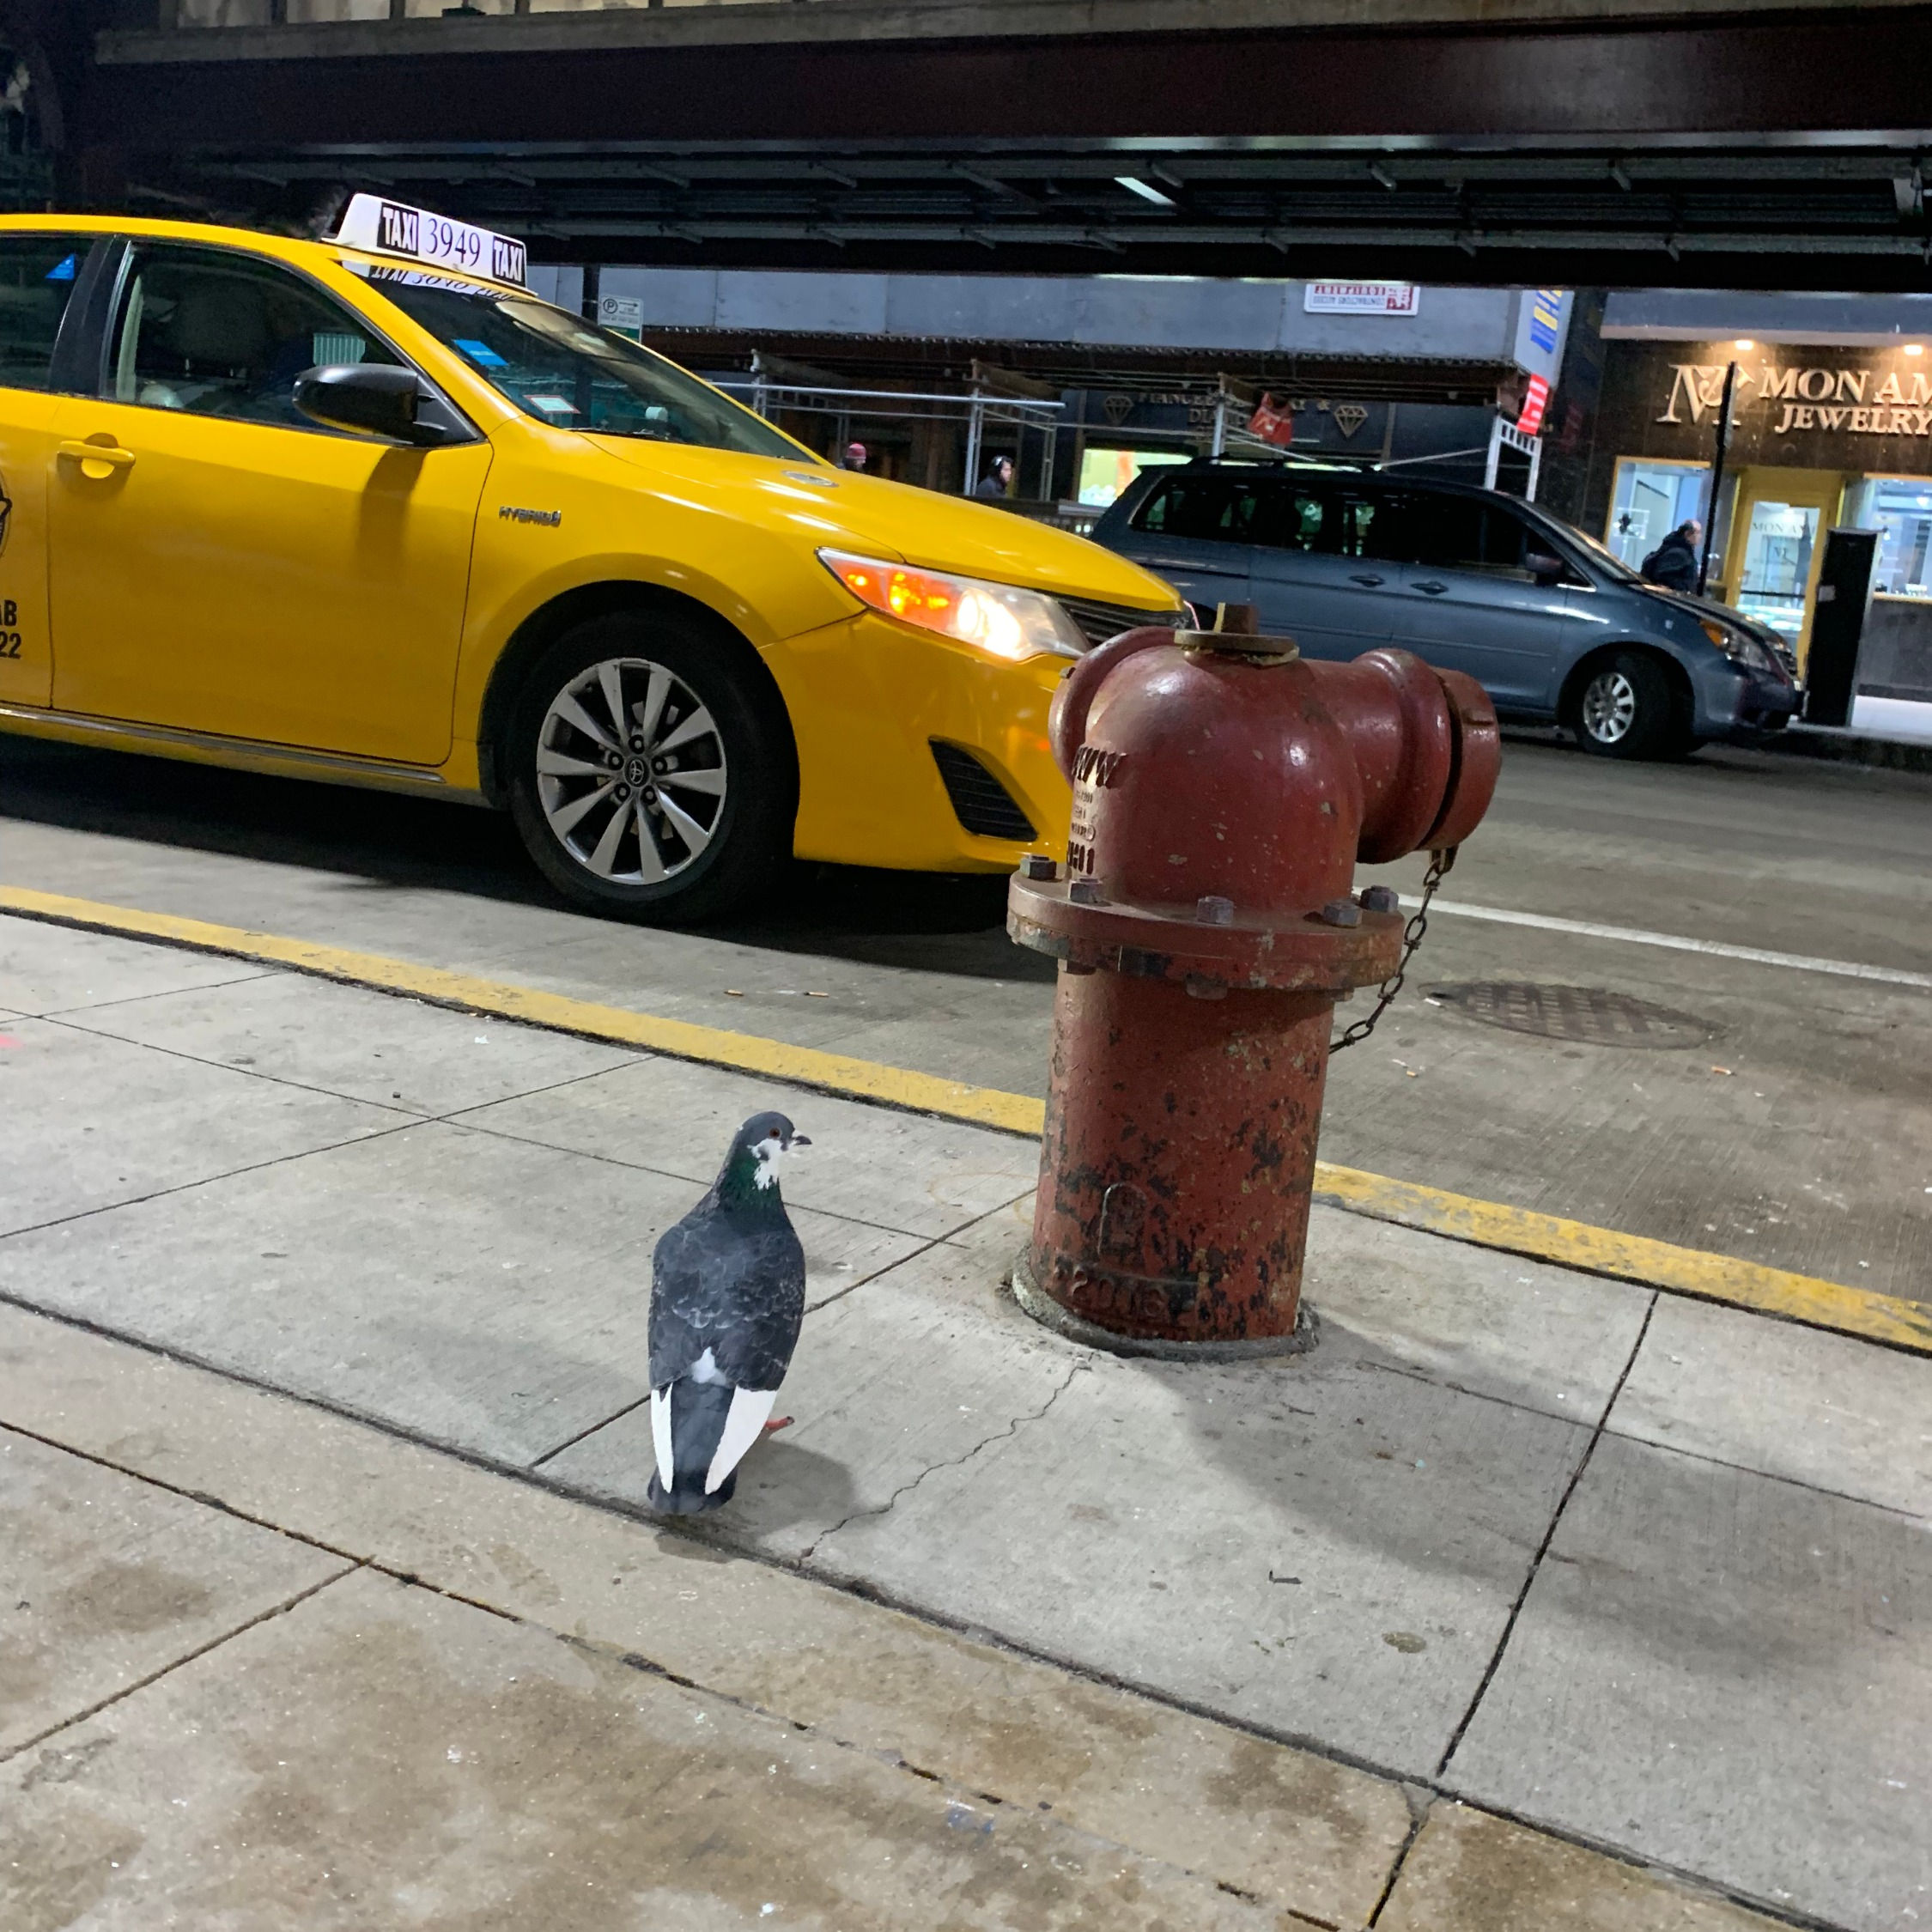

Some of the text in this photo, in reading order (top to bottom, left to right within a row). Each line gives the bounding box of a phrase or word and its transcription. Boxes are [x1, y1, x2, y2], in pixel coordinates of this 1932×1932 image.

[383, 207, 523, 283] TAXI 3949 TAXI
[1758, 366, 1870, 404] MON
[1774, 403, 1932, 436] JEWELRY
